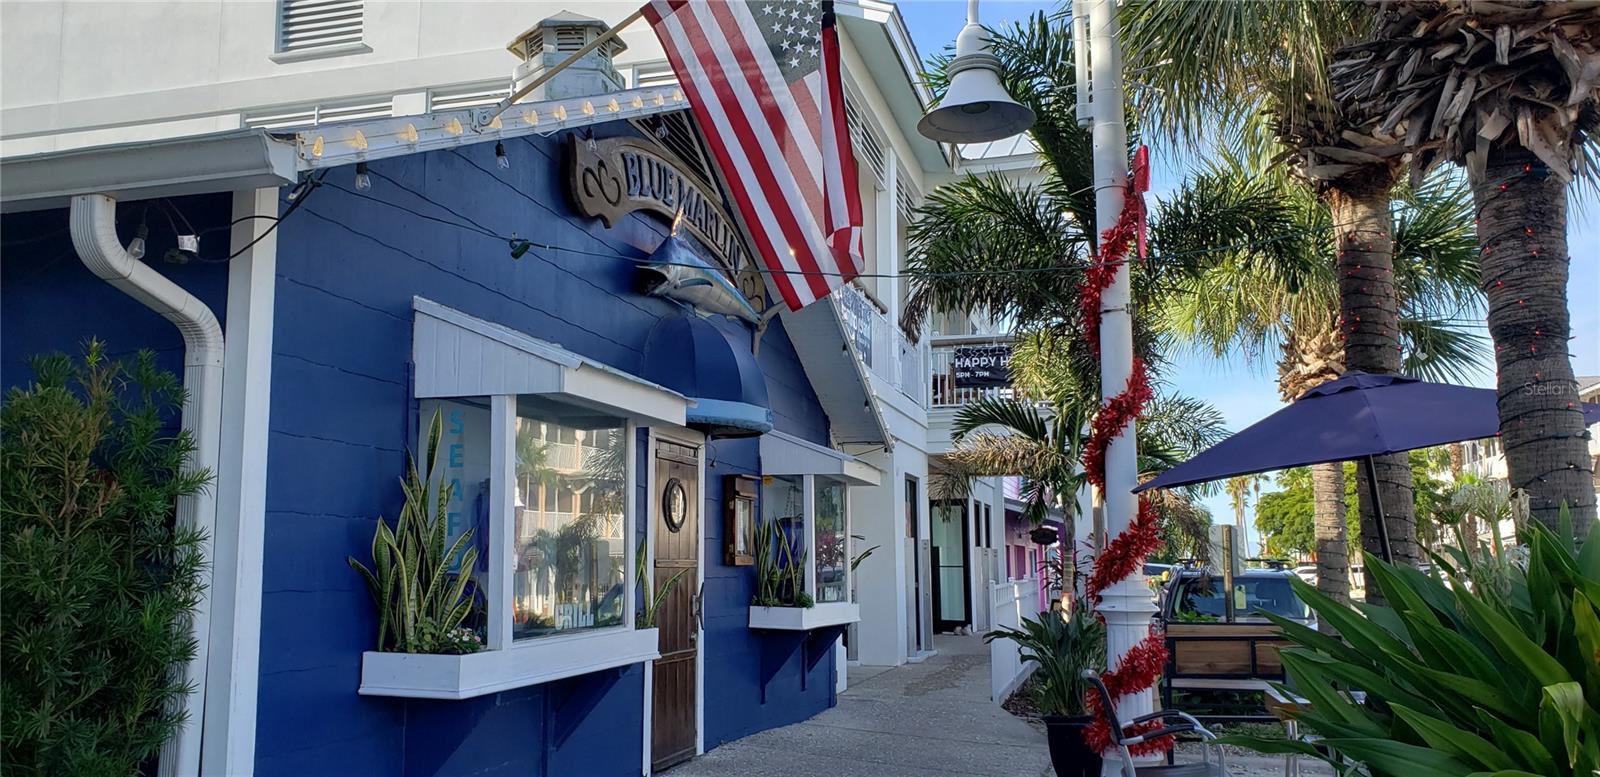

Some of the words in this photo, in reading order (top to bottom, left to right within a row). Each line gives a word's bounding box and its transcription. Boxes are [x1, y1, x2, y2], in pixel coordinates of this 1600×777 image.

[621, 152, 675, 207] BLUE
[677, 176, 742, 275] MARLIN
[955, 356, 997, 368] HAPPY
[555, 602, 594, 631] GRILL
